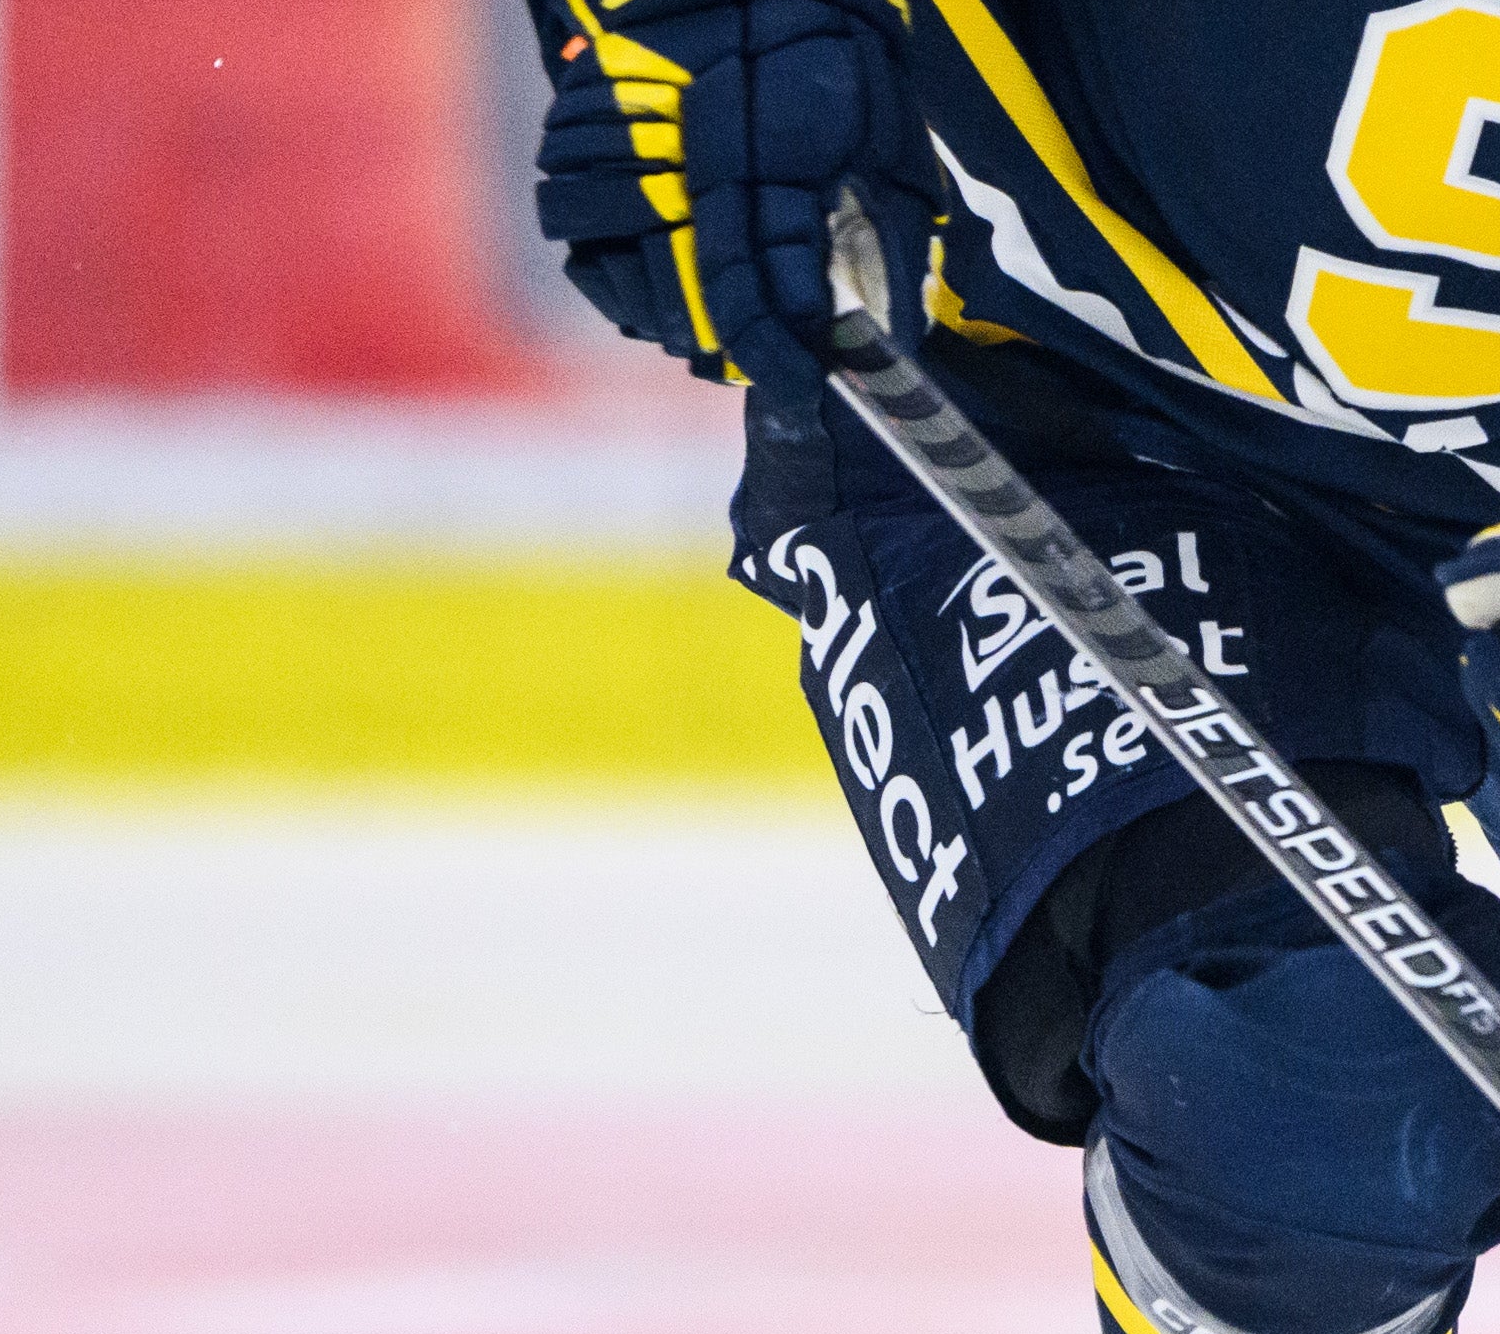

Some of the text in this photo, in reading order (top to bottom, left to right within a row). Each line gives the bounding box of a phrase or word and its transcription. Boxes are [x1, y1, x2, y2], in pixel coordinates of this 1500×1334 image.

[969, 531, 1210, 657] Sal
[950, 619, 1250, 812] Hust
[1046, 710, 1150, 815] .se
[1137, 683, 1461, 989] JETSPEED
